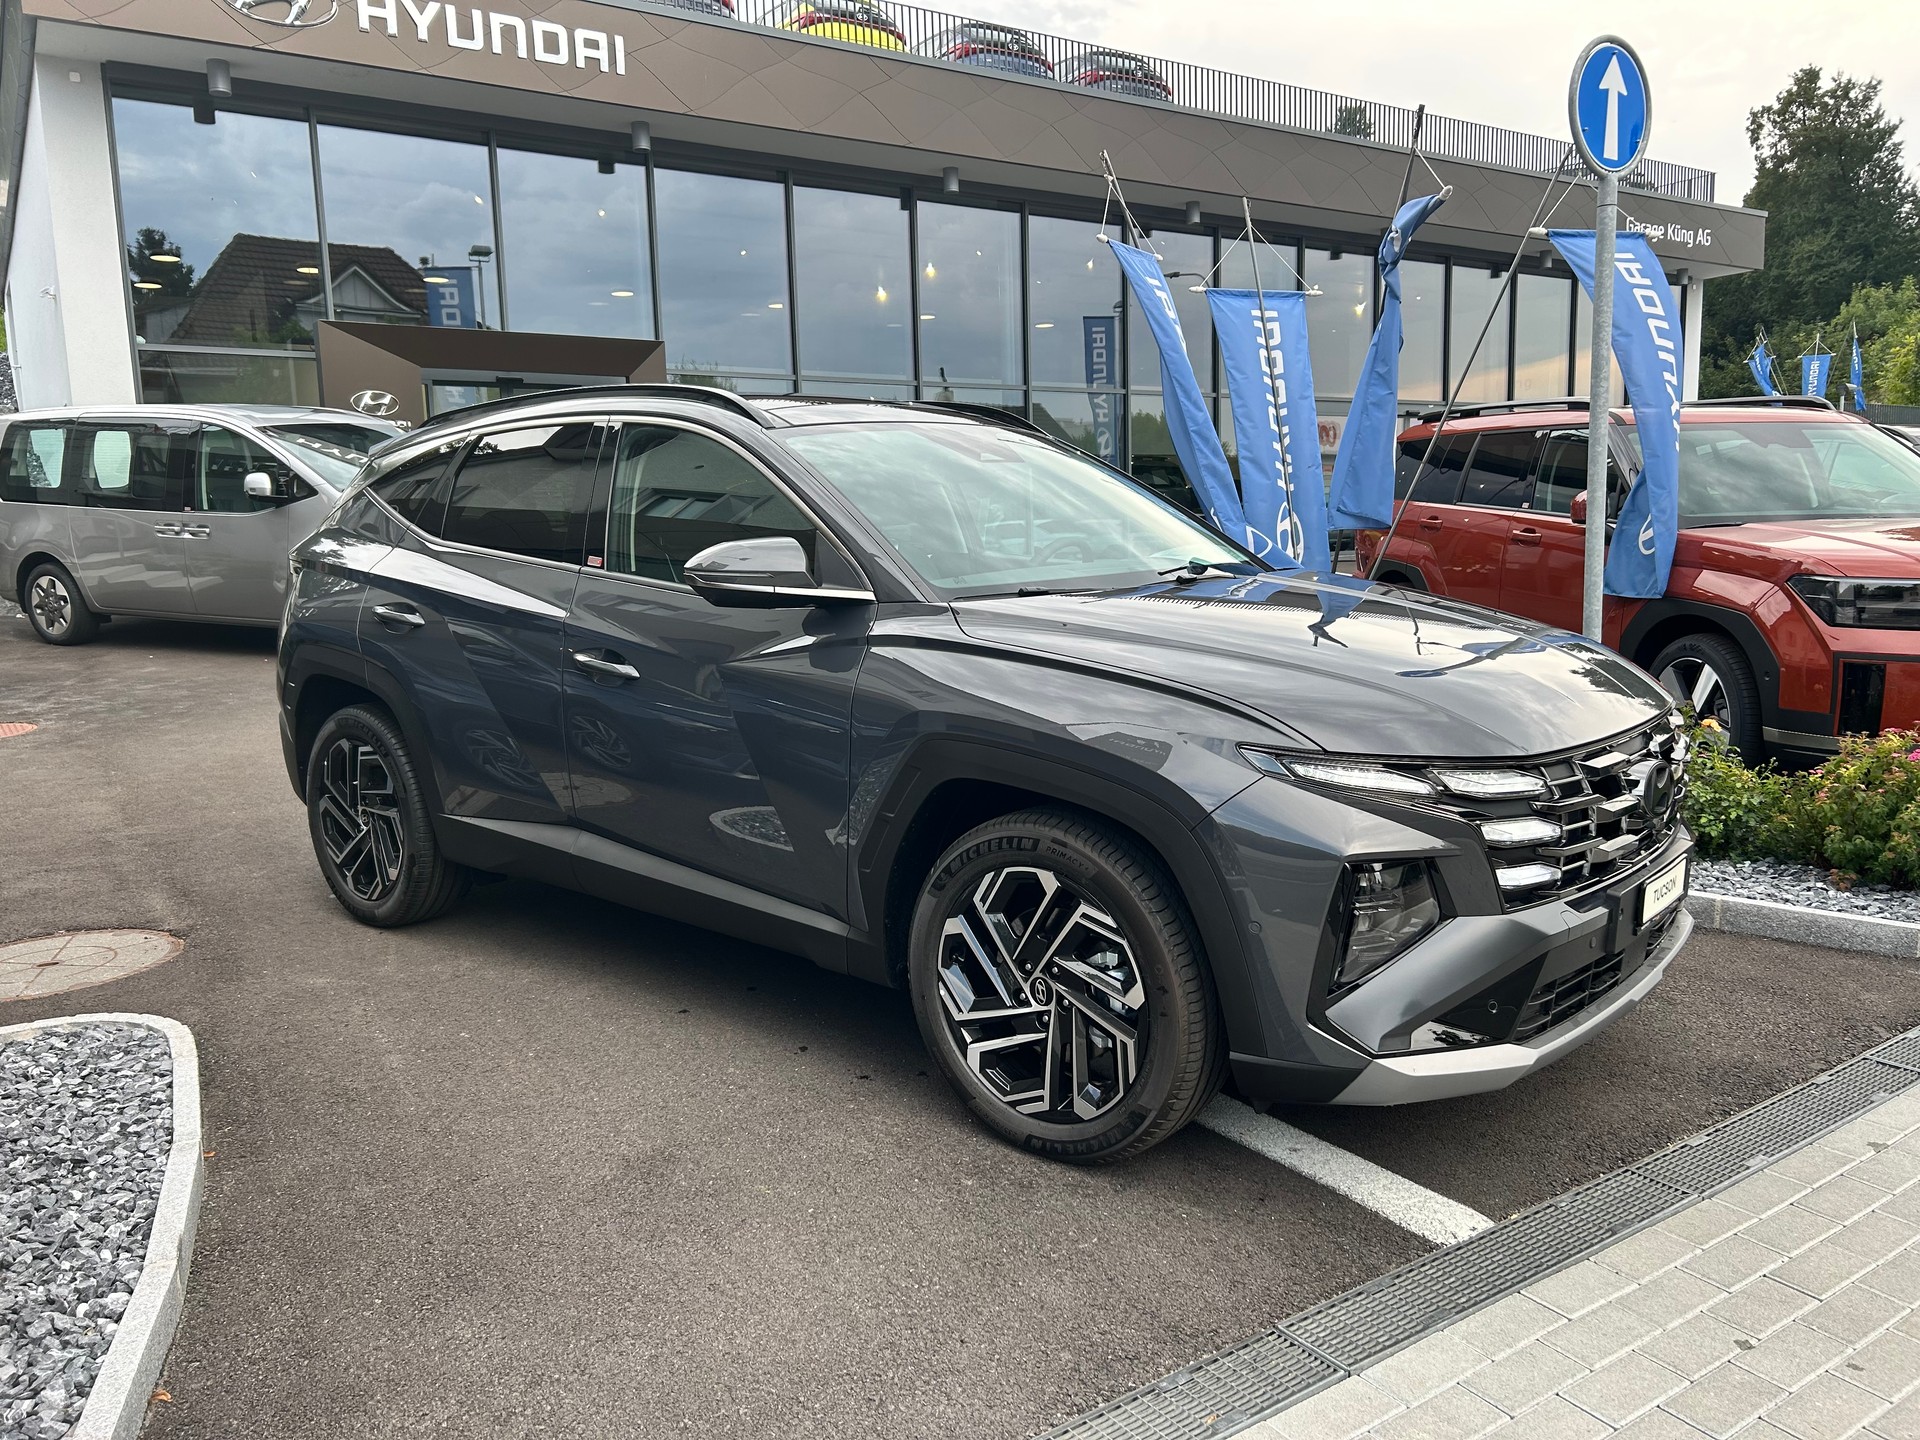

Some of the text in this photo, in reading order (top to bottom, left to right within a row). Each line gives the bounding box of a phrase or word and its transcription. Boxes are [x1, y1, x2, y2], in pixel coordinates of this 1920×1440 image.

[357, 0, 626, 76] HYUNDAI
[1667, 223, 1693, 247] Küng
[1696, 228, 1711, 246] AG
[950, 837, 1084, 874] MICHELIN PRIMACY
[1653, 875, 1677, 904] TUCSON
